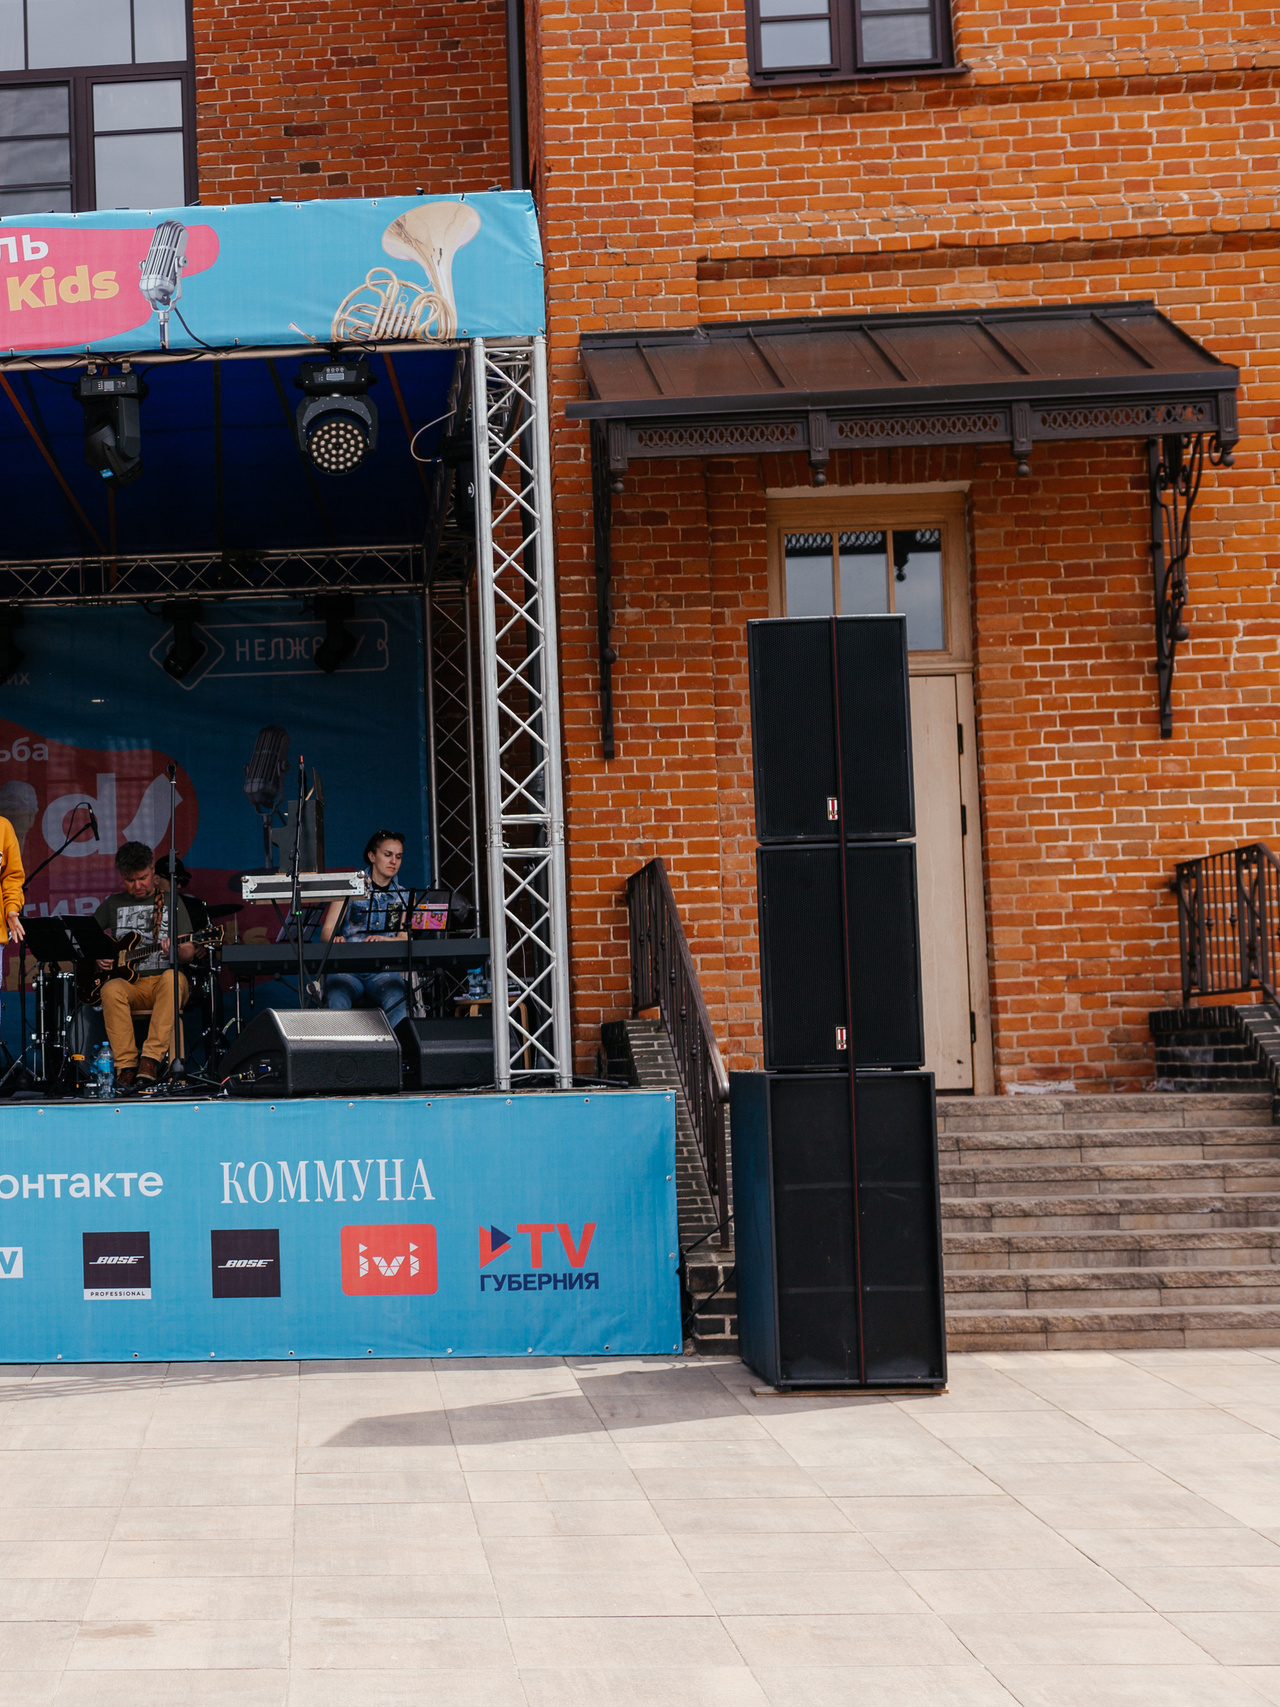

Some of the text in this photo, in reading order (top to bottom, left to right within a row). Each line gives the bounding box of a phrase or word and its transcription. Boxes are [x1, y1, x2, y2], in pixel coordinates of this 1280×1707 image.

[6, 265, 120, 312] Kids
[219, 1158, 436, 1204] КОММУНА
[88, 1255, 145, 1265] BOSE
[217, 1258, 274, 1269] BOSE
[358, 1242, 420, 1278] ivi
[516, 1222, 597, 1269] TV
[479, 1271, 600, 1292] ГУБЕРНИЯ
